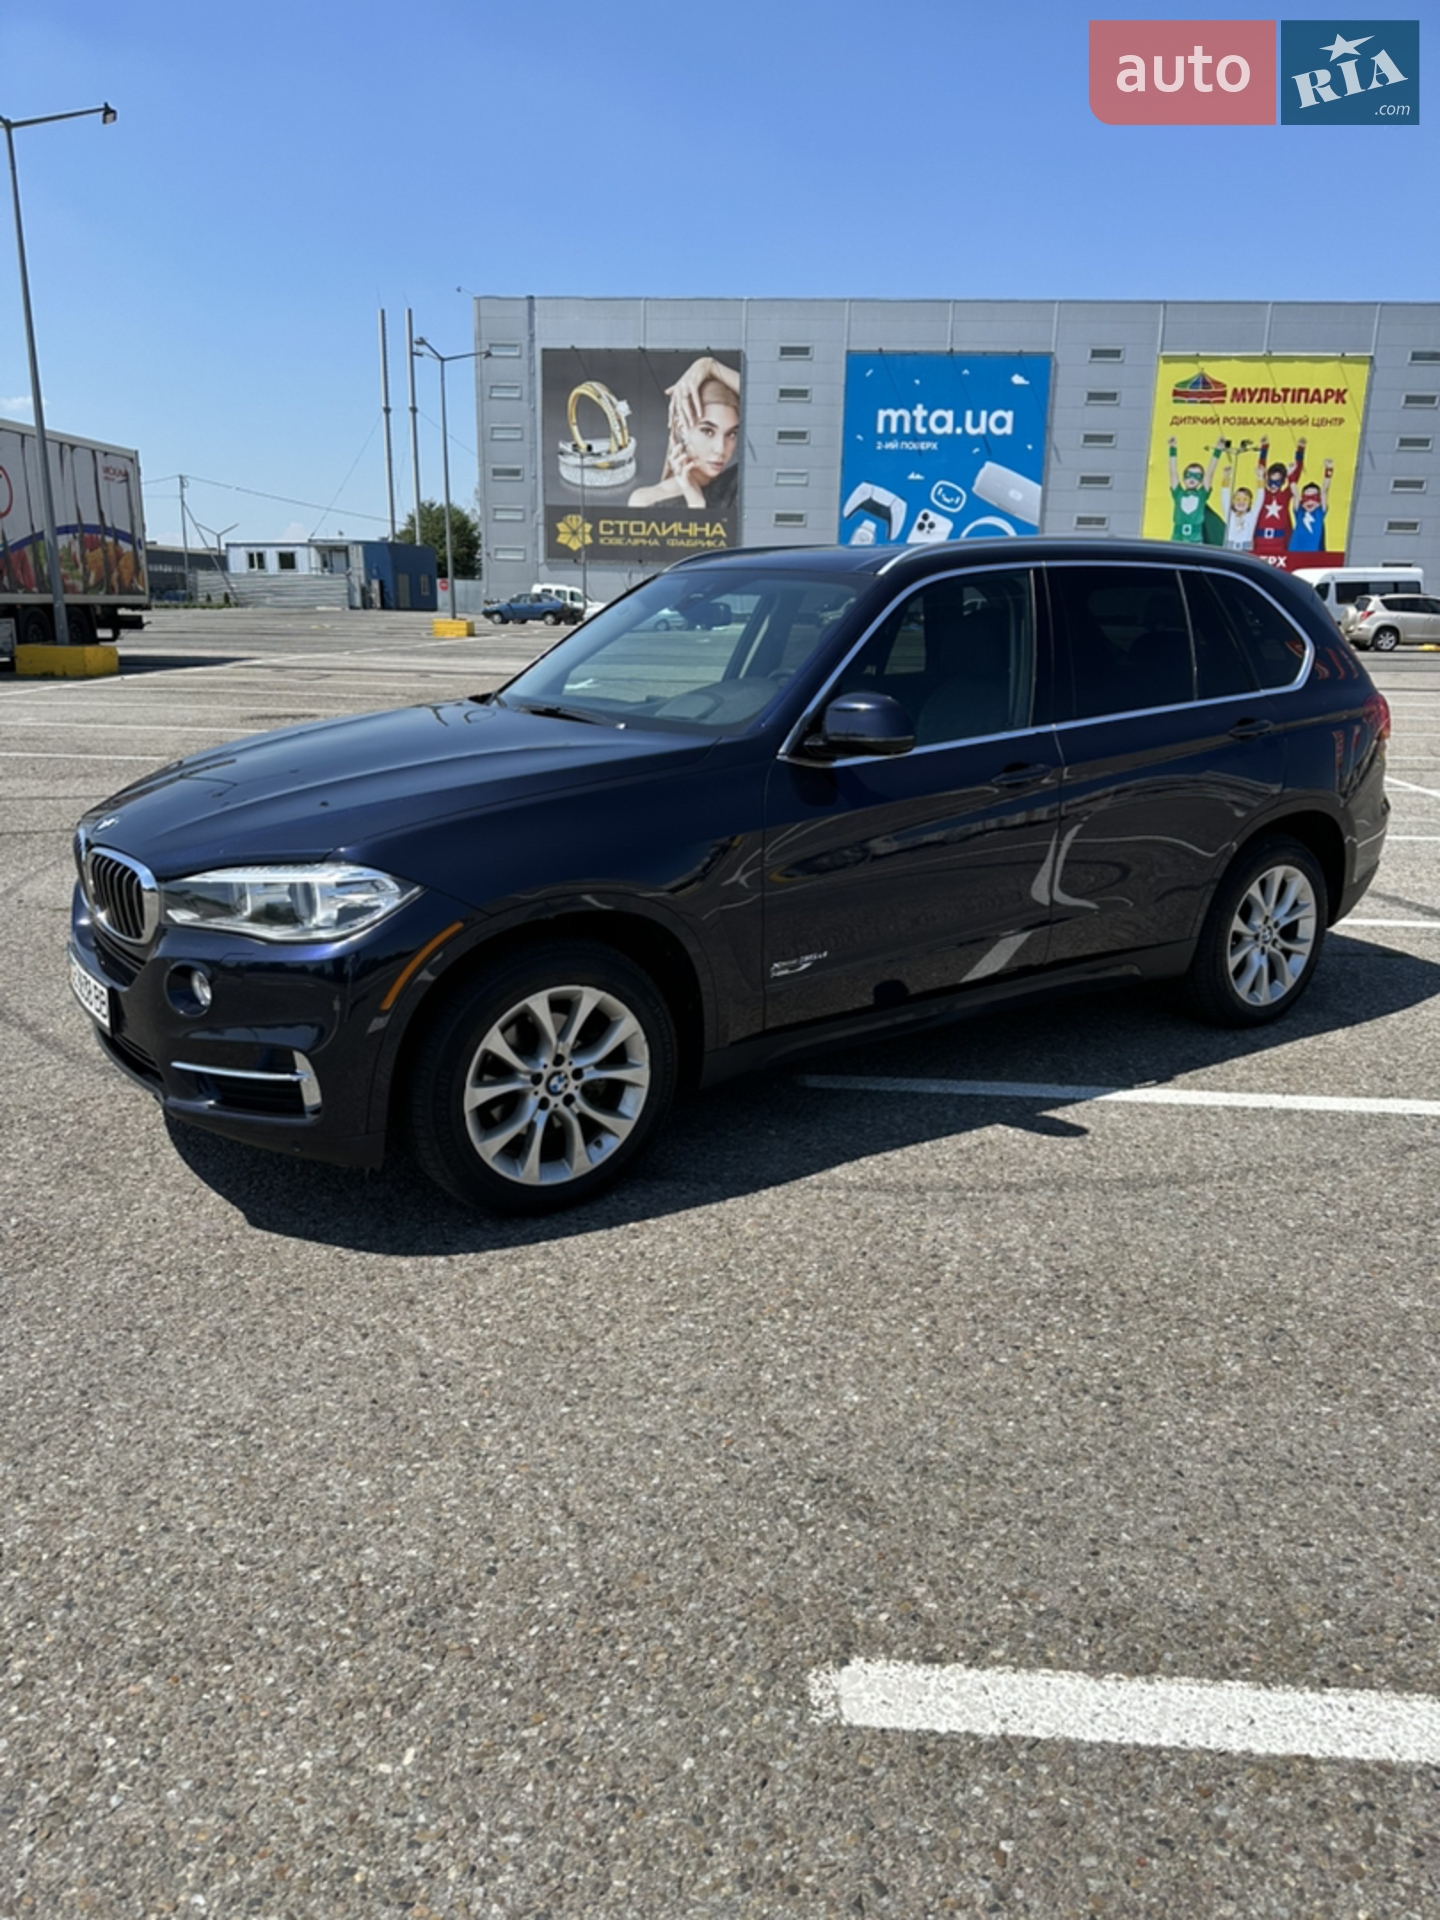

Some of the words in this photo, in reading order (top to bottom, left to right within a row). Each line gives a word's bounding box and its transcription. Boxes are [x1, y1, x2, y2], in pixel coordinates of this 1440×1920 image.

[1230, 387, 1348, 405] МУЛЬТІПАРК
[876, 403, 1014, 435] mta.ua
[1170, 415, 1220, 427] ДИТЯЧИЙ
[1222, 415, 1309, 427] РОЗВАЖАЛЬНИЙ
[1312, 417, 1345, 428] ЦЕНТР
[599, 519, 727, 537] СТОЛИЧНА
[666, 539, 727, 548] ФАБРИКА
